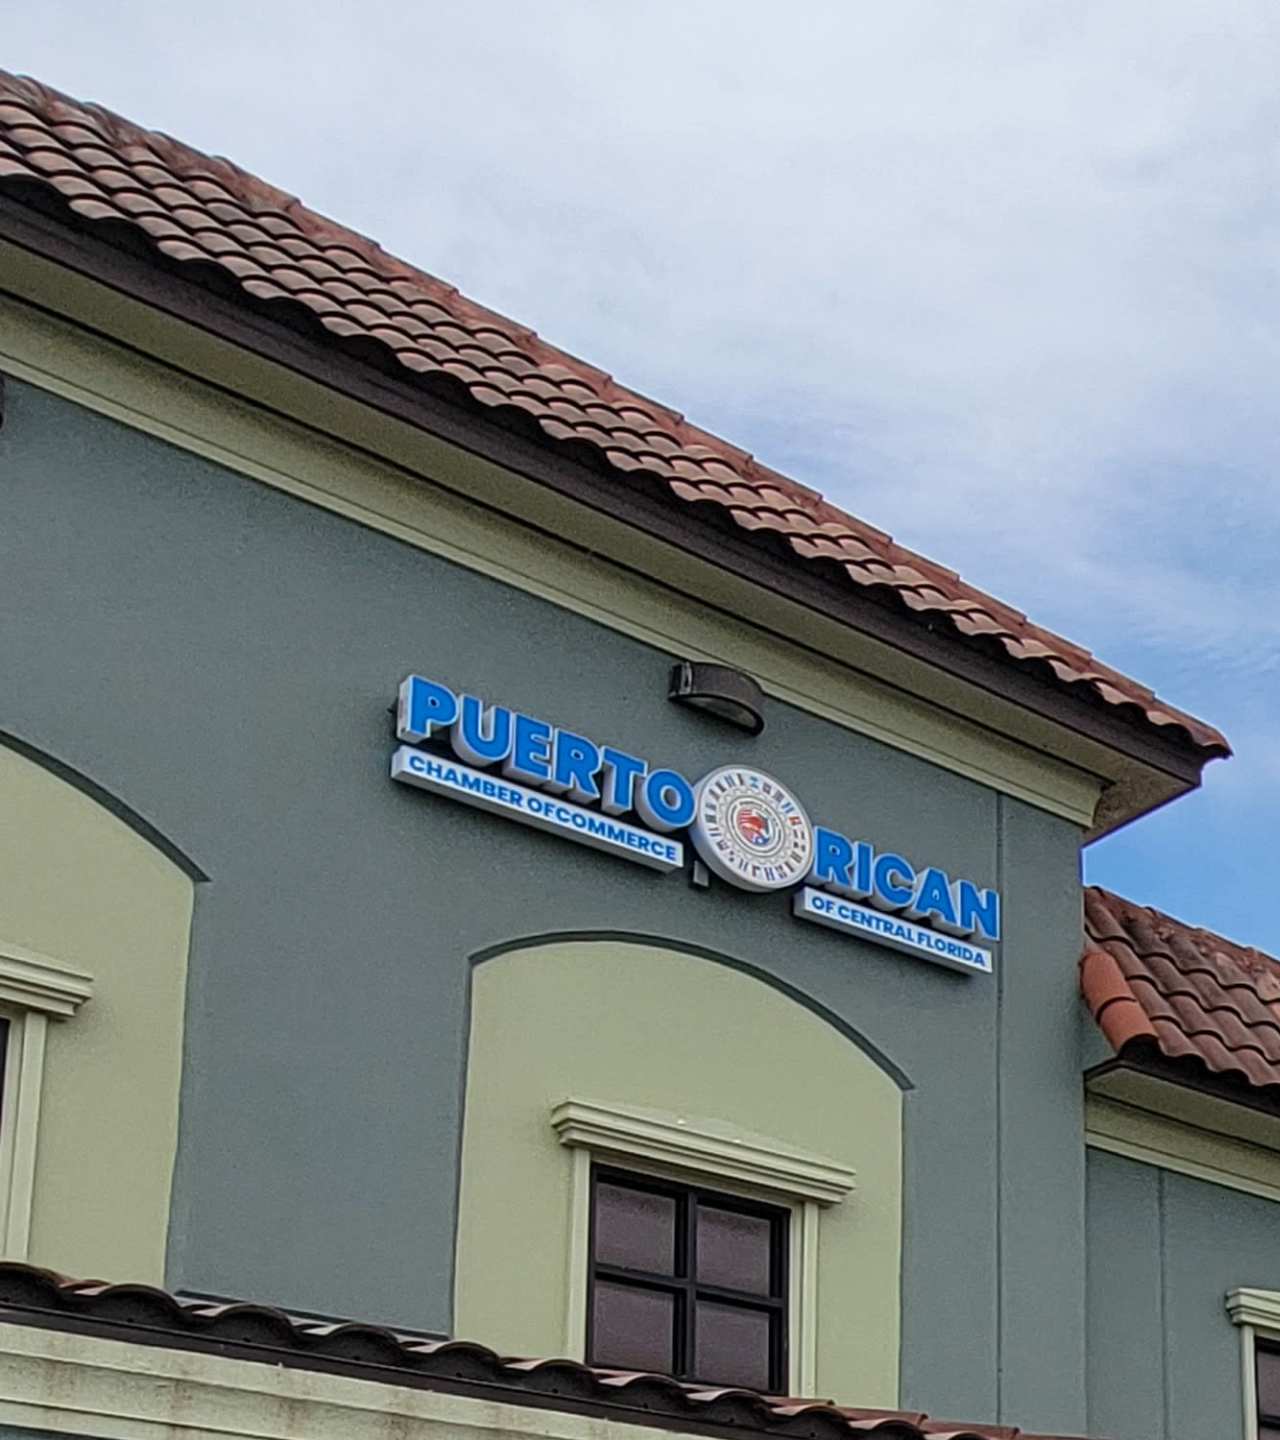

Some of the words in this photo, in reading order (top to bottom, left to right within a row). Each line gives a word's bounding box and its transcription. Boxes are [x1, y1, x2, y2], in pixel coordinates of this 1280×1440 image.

[400, 674, 696, 829] PUERTO
[409, 755, 523, 808] CHAMBER
[814, 825, 999, 940] RICAN
[811, 896, 835, 913] OF
[837, 904, 915, 942] CENTRAL
[917, 933, 986, 967] FLORIDA
